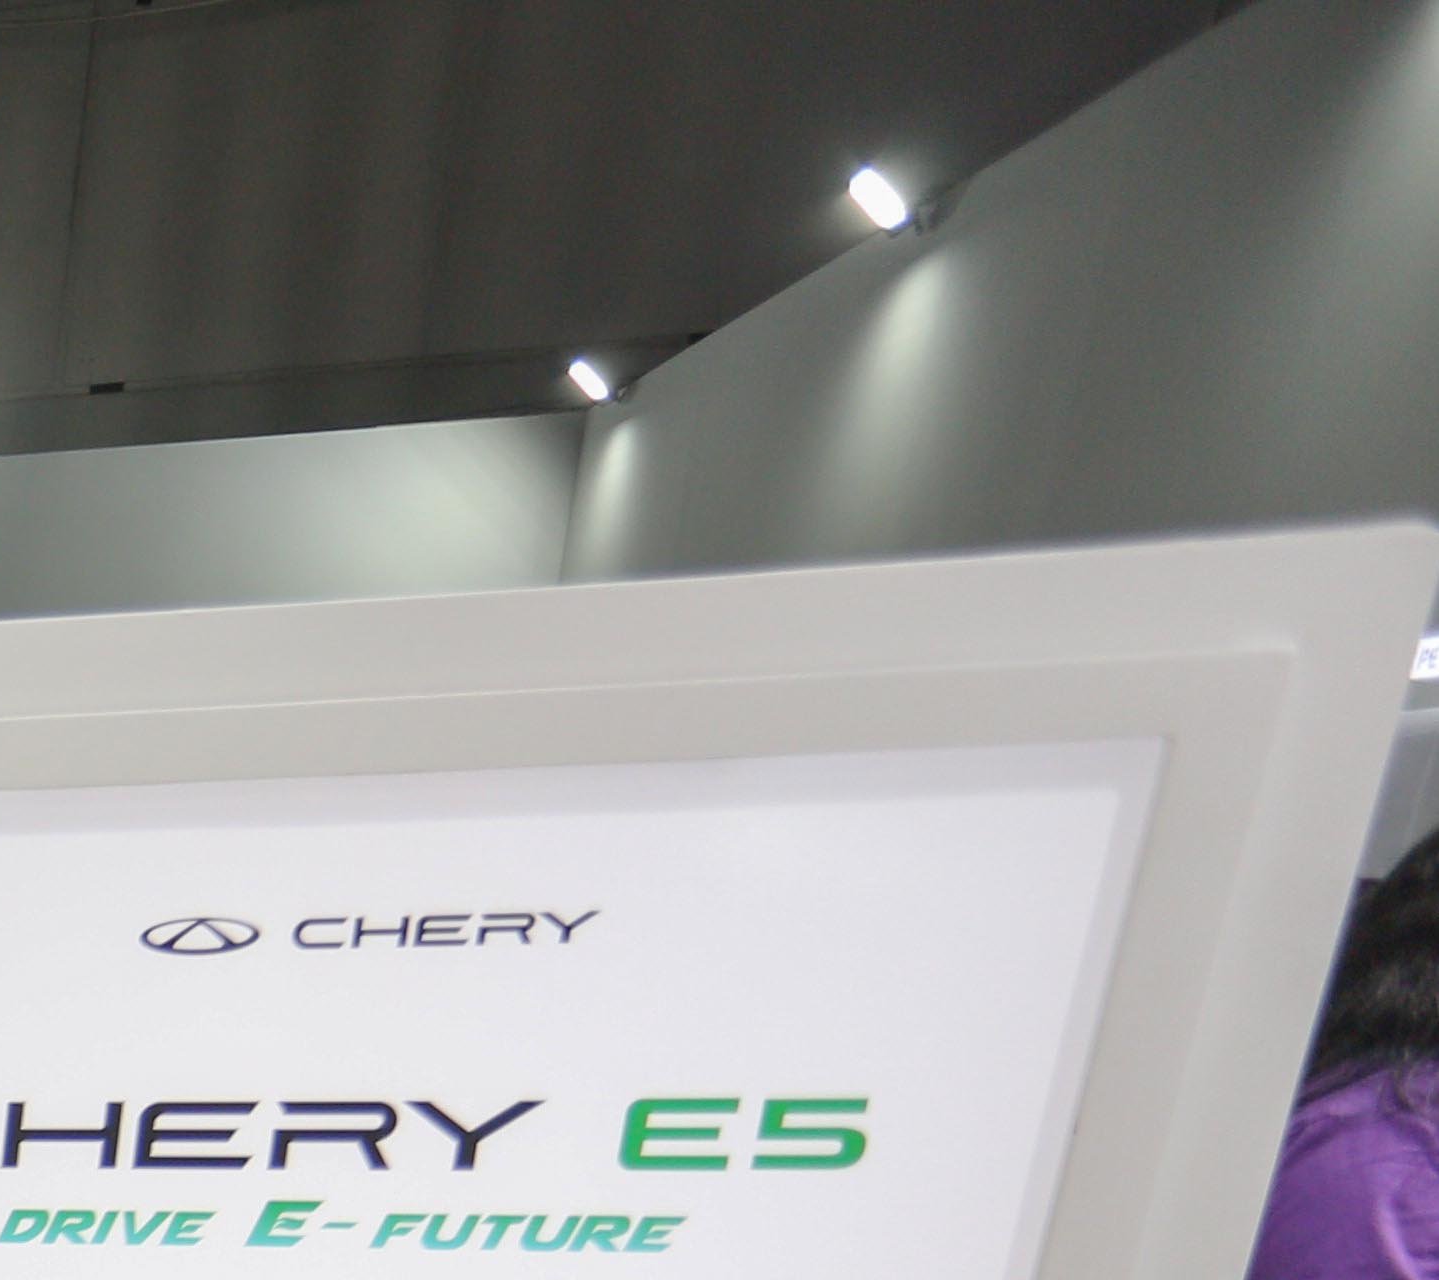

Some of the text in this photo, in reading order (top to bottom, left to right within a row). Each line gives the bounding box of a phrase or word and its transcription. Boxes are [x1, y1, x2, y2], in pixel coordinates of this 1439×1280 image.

[290, 909, 601, 950] CHERY
[616, 1097, 870, 1171] E5
[369, 1213, 689, 1253] FUTURE
